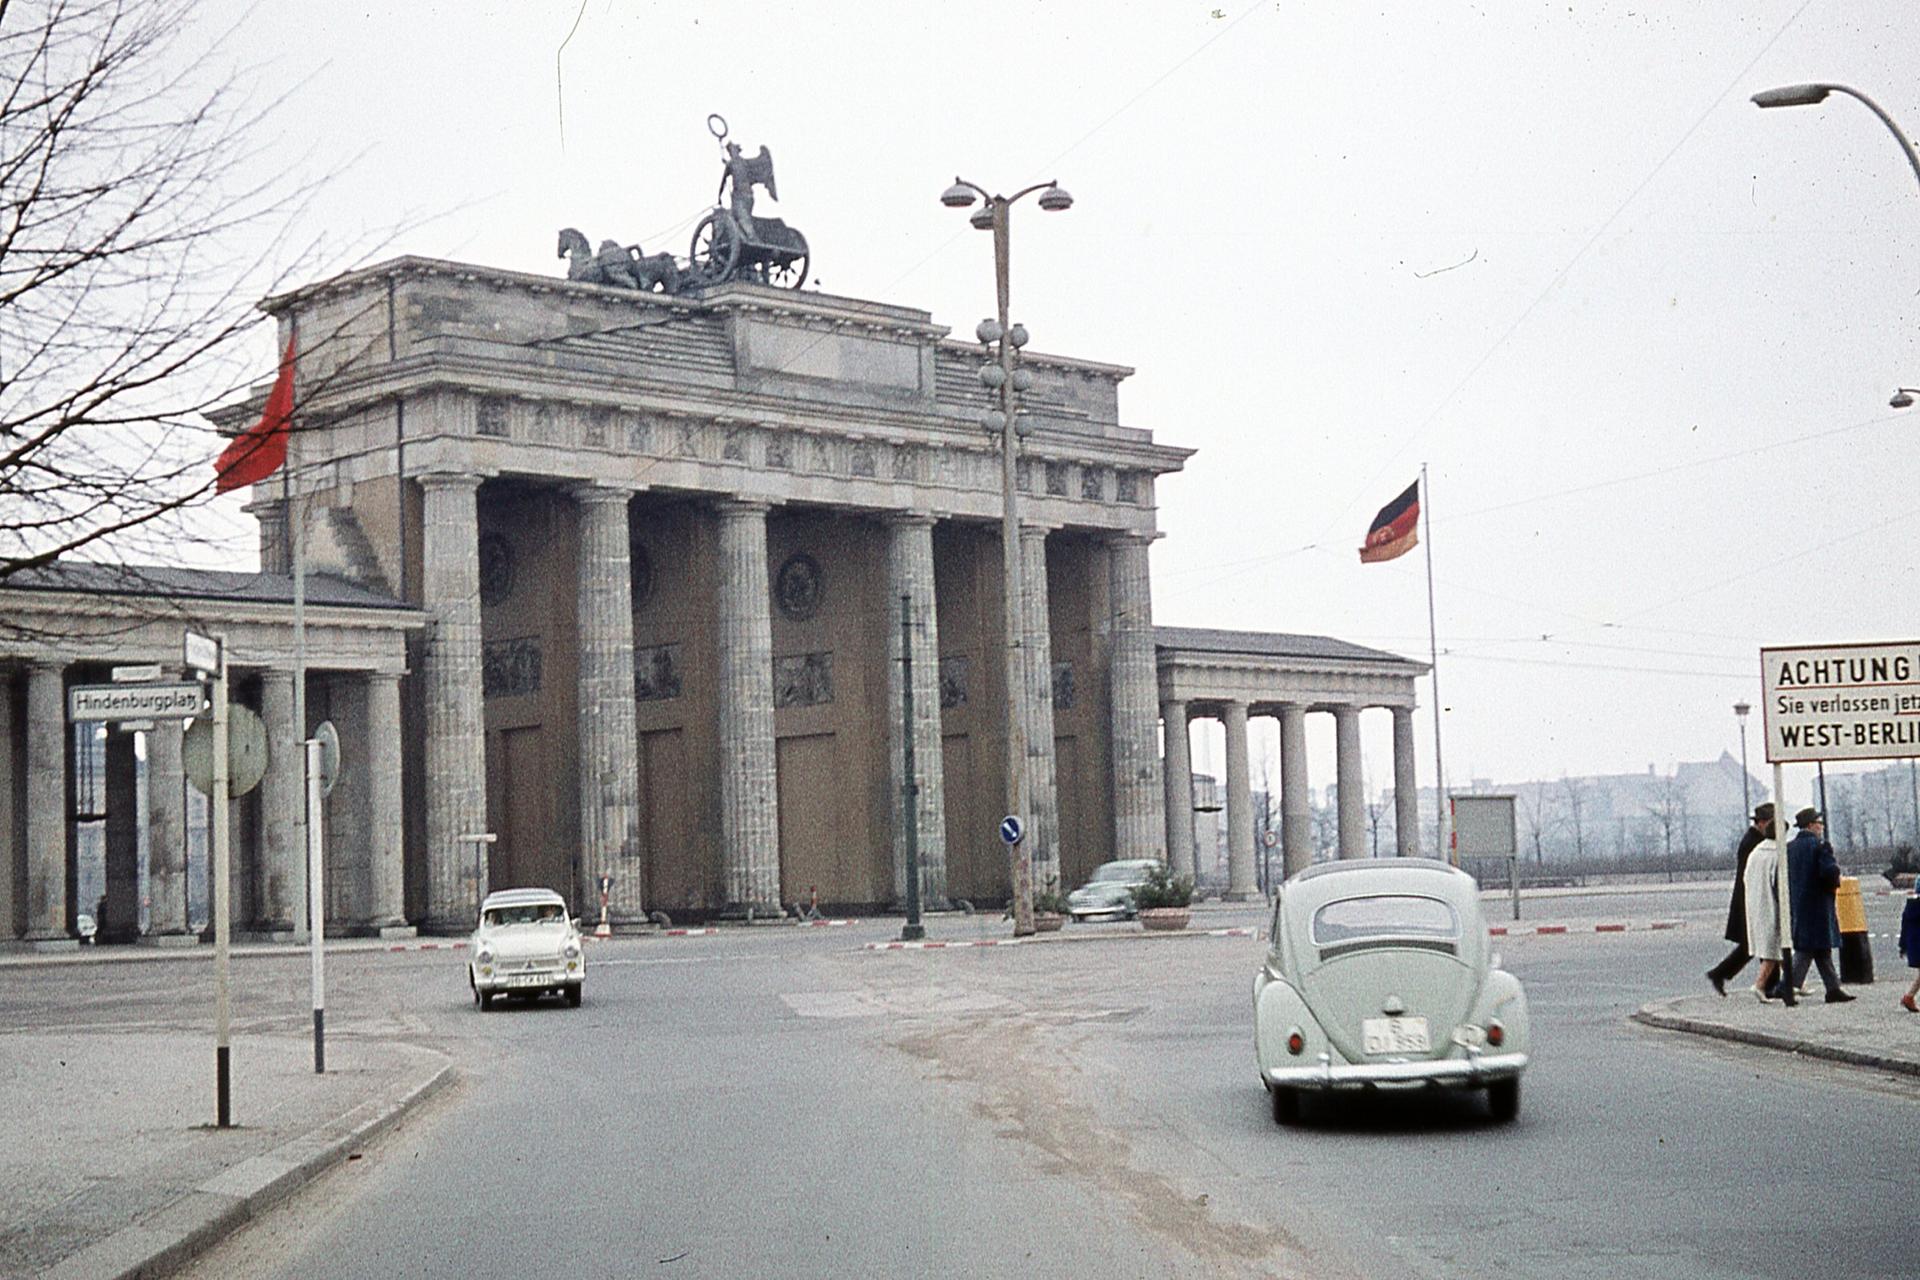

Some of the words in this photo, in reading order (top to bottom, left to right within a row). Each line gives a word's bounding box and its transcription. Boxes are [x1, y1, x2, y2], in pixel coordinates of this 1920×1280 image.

[1779, 657, 1920, 686] ACHTUNG
[77, 692, 196, 711] Hindenburgplatz
[1778, 696, 1805, 714] Sie
[1810, 694, 1889, 713] verlassen
